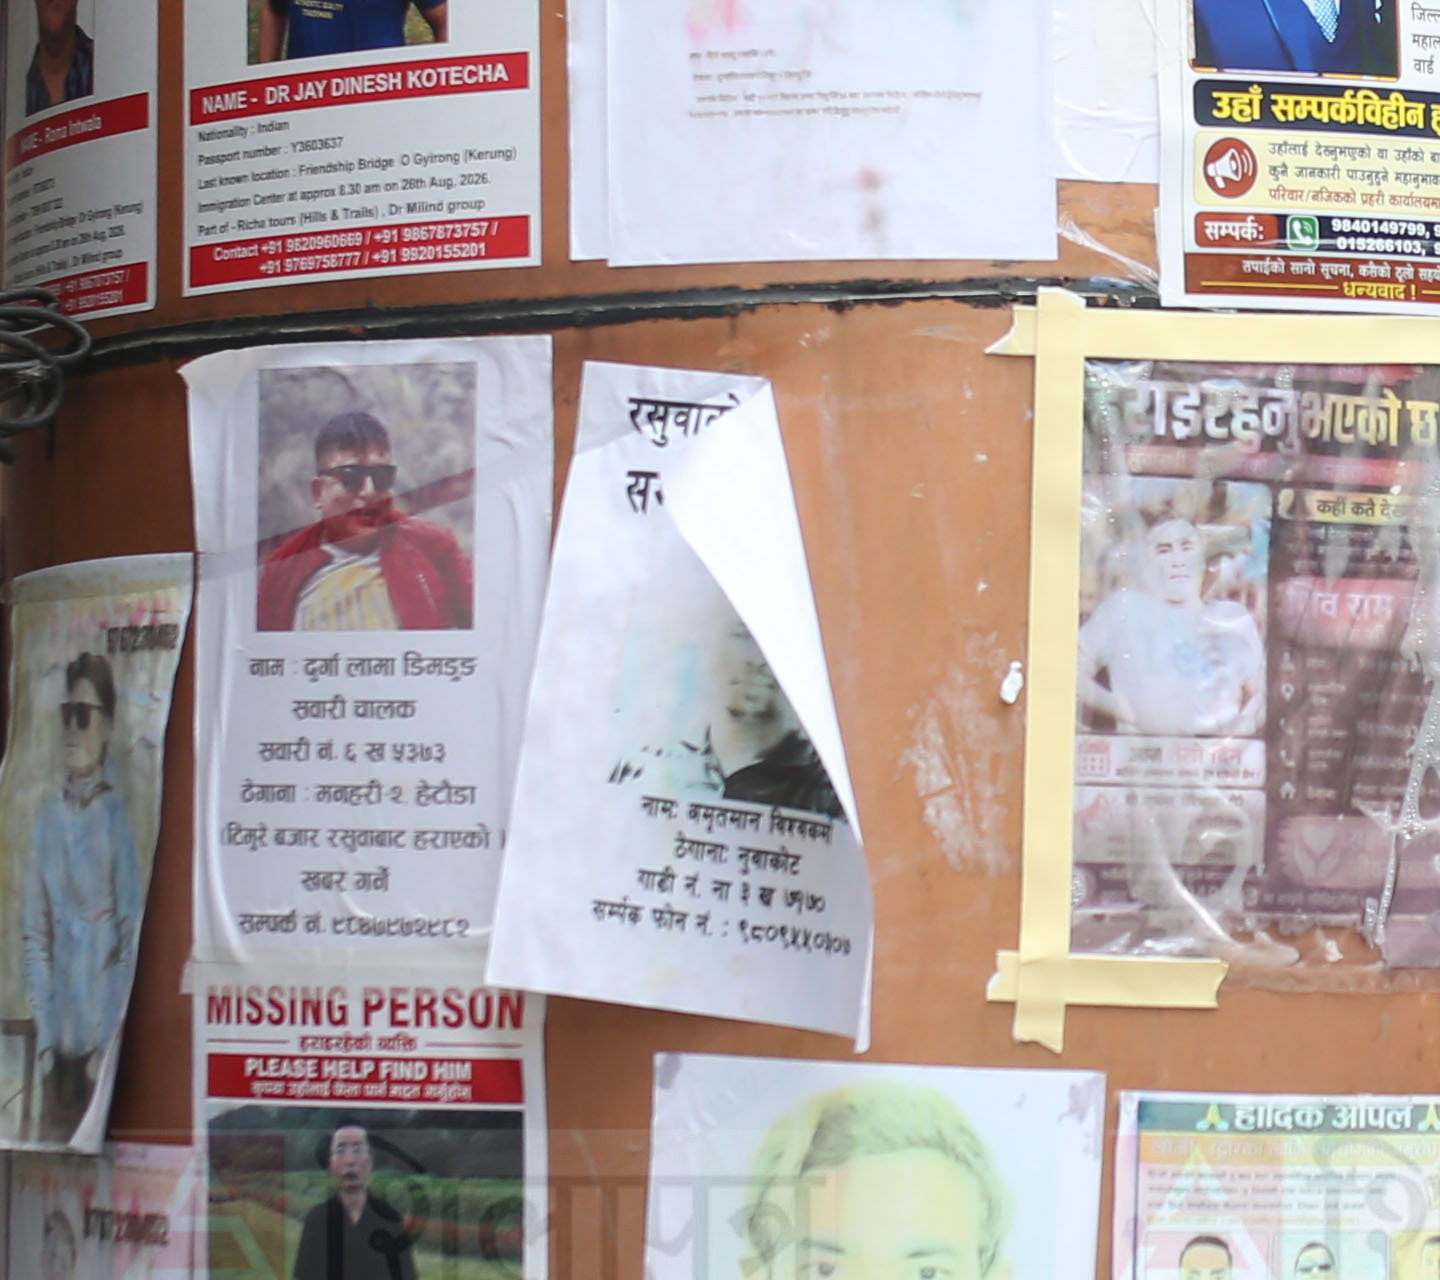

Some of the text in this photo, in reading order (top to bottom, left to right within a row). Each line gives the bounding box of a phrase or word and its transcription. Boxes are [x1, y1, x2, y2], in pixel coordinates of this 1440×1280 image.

[1413, 55, 1435, 75] वार्ड
[202, 63, 509, 114] NAME DR JAY DINESH KOTECHA
[1212, 84, 1425, 130] उहाँ सम्पर्कविहीन
[198, 120, 289, 143] Nationality Indian
[198, 149, 240, 167] Passport
[242, 146, 282, 159] number
[251, 147, 516, 182] location Friendship Bridge Gyirong (Kerung)
[1294, 163, 1340, 181] जानकारी
[1331, 219, 1430, 239] 9840149799,
[214, 245, 258, 262] Contact
[1336, 237, 1426, 256] 015266103,
[1343, 280, 1406, 300] धन्यवाद
[249, 657, 285, 678] नाम
[304, 652, 339, 683] दुर्गा
[346, 657, 395, 678] लामा
[292, 694, 418, 721] सवारी चालक
[259, 736, 310, 763] सवारी
[241, 778, 296, 804] ठेगाना
[414, 824, 491, 850] हराएको
[302, 870, 347, 893] खबर
[363, 986, 526, 1029] PERSON
[245, 1058, 472, 1081] PLEASE HELP FIND HIM
